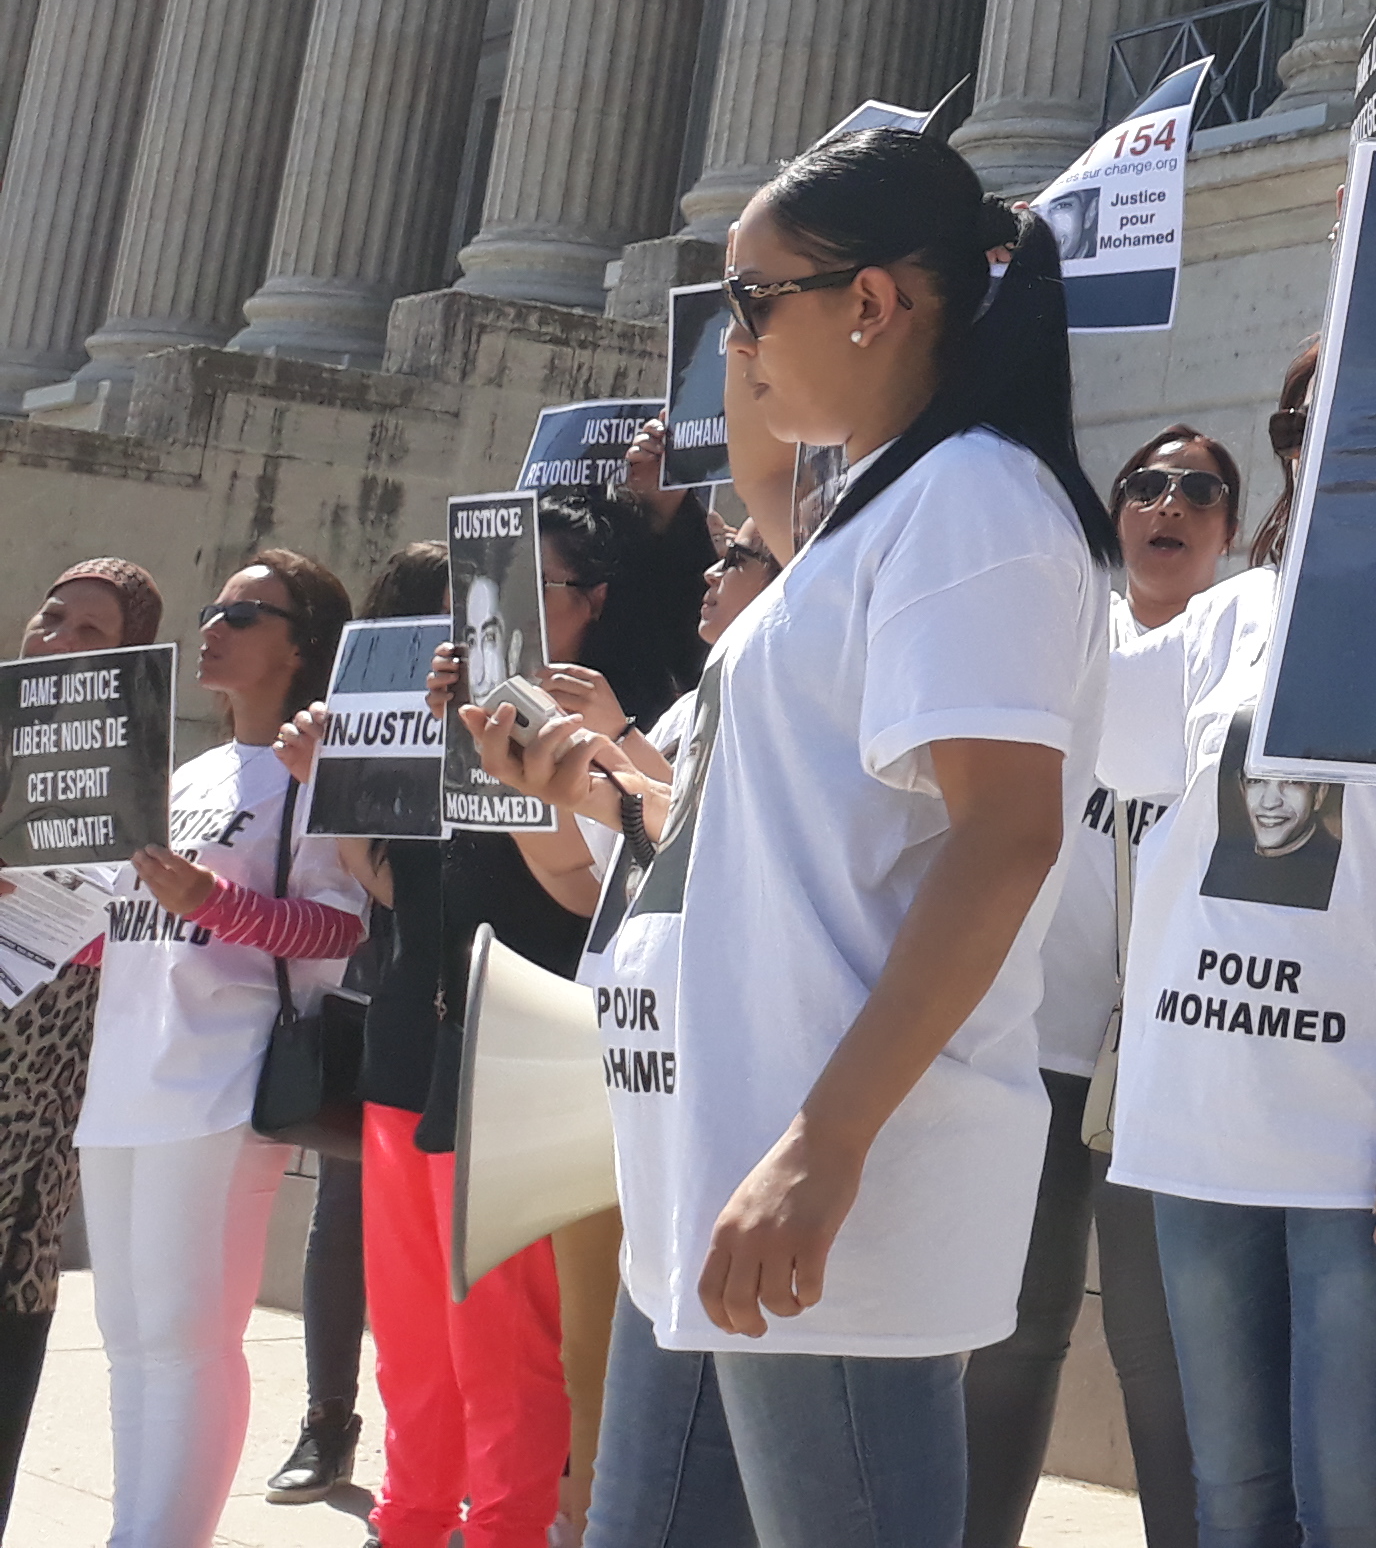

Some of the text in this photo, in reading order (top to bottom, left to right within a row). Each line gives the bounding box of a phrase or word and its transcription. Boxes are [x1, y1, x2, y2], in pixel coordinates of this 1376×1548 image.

[1113, 118, 1176, 159] 154
[1104, 157, 1178, 176] change.org
[1111, 190, 1166, 207] Justice
[1120, 213, 1155, 230] pour
[1099, 230, 1175, 250] Mohamed
[524, 460, 593, 486] REVOQUE
[454, 507, 523, 539] JUSTICE
[20, 668, 121, 708] DAME JUSTICE
[12, 716, 129, 756] LIBÈRE NOUS DE
[27, 766, 112, 803] CET ESPRIT
[446, 794, 544, 823] MOHAMED
[26, 815, 116, 850] VINDICATIF!
[1197, 948, 1302, 994] POUR
[597, 986, 660, 1031] POUR
[1155, 988, 1346, 1043] MOHAMED
